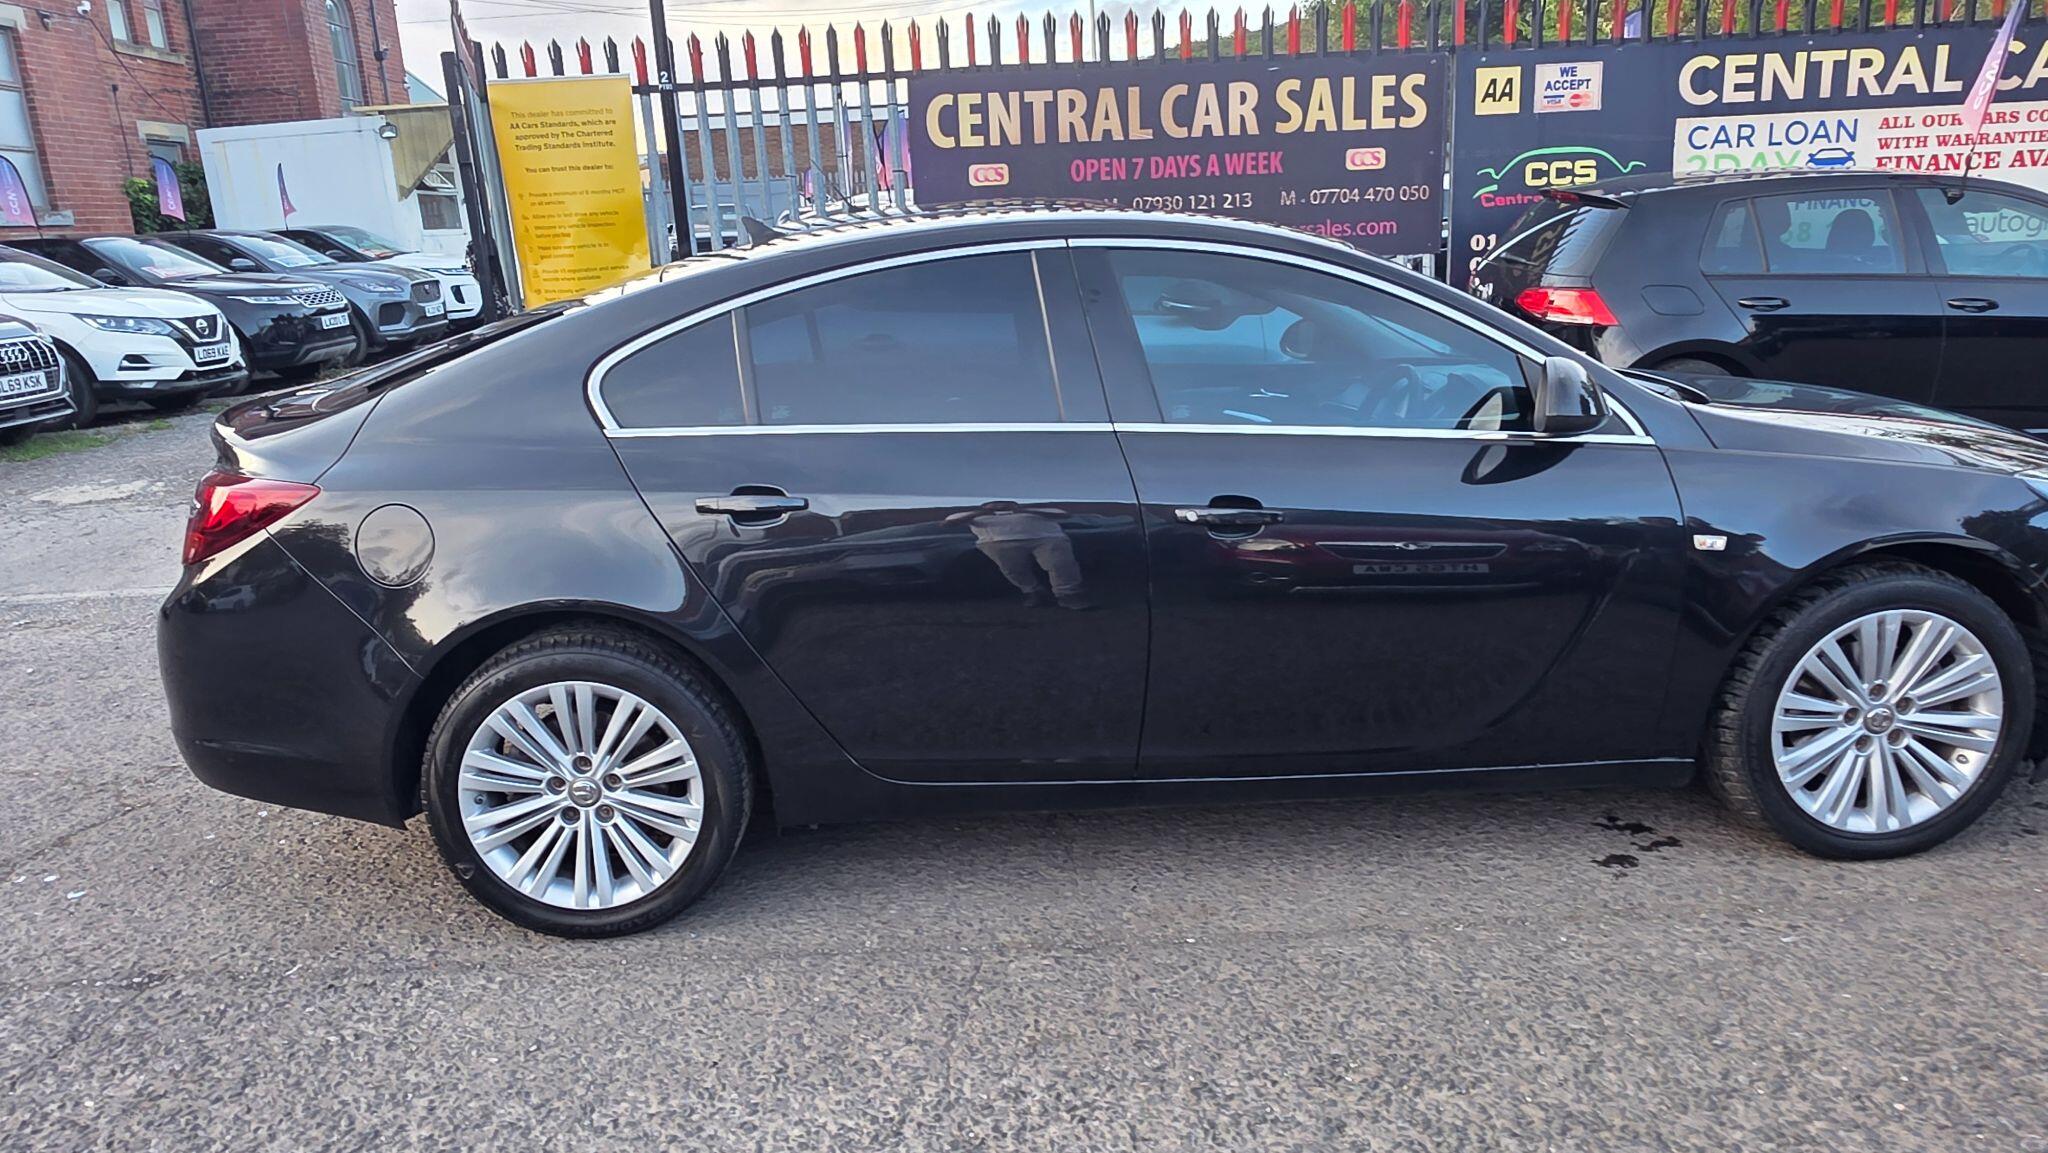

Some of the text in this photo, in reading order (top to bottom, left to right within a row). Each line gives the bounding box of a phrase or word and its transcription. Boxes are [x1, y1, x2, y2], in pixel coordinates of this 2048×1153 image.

[660, 71, 669, 83] 2
[1559, 66, 1578, 78] WE
[1677, 44, 1963, 105] CENTRAL
[1480, 77, 1514, 103] AA
[1544, 79, 1592, 91] ACCEPT
[527, 110, 549, 118] dealer
[925, 73, 1428, 149] CENTRAL CAR SALES
[1878, 115, 1916, 130] ALL
[1921, 112, 1964, 128] OUR
[1982, 111, 2020, 125] ARS
[540, 120, 580, 128] Standards,
[1687, 117, 1859, 150] CAR LOAN
[515, 133, 549, 141] approved
[551, 131, 559, 140] by
[576, 129, 613, 137] Chartered
[1877, 135, 1930, 151] WITH
[515, 144, 542, 152] Trading
[544, 142, 581, 150] Standards
[1069, 151, 1284, 183] OPEN 7 DAYS A WEEK
[1875, 150, 2001, 171] FINANCE
[1524, 159, 1597, 187] CCS
[1132, 195, 1183, 211] 07930
[1188, 194, 1216, 209] 121
[1223, 192, 1253, 208] 213
[1280, 190, 1296, 206] M
[1310, 187, 1360, 205] 07704
[1364, 186, 1395, 202] 470
[1399, 185, 1430, 201] 050
[0, 374, 43, 393] L69 KSK
